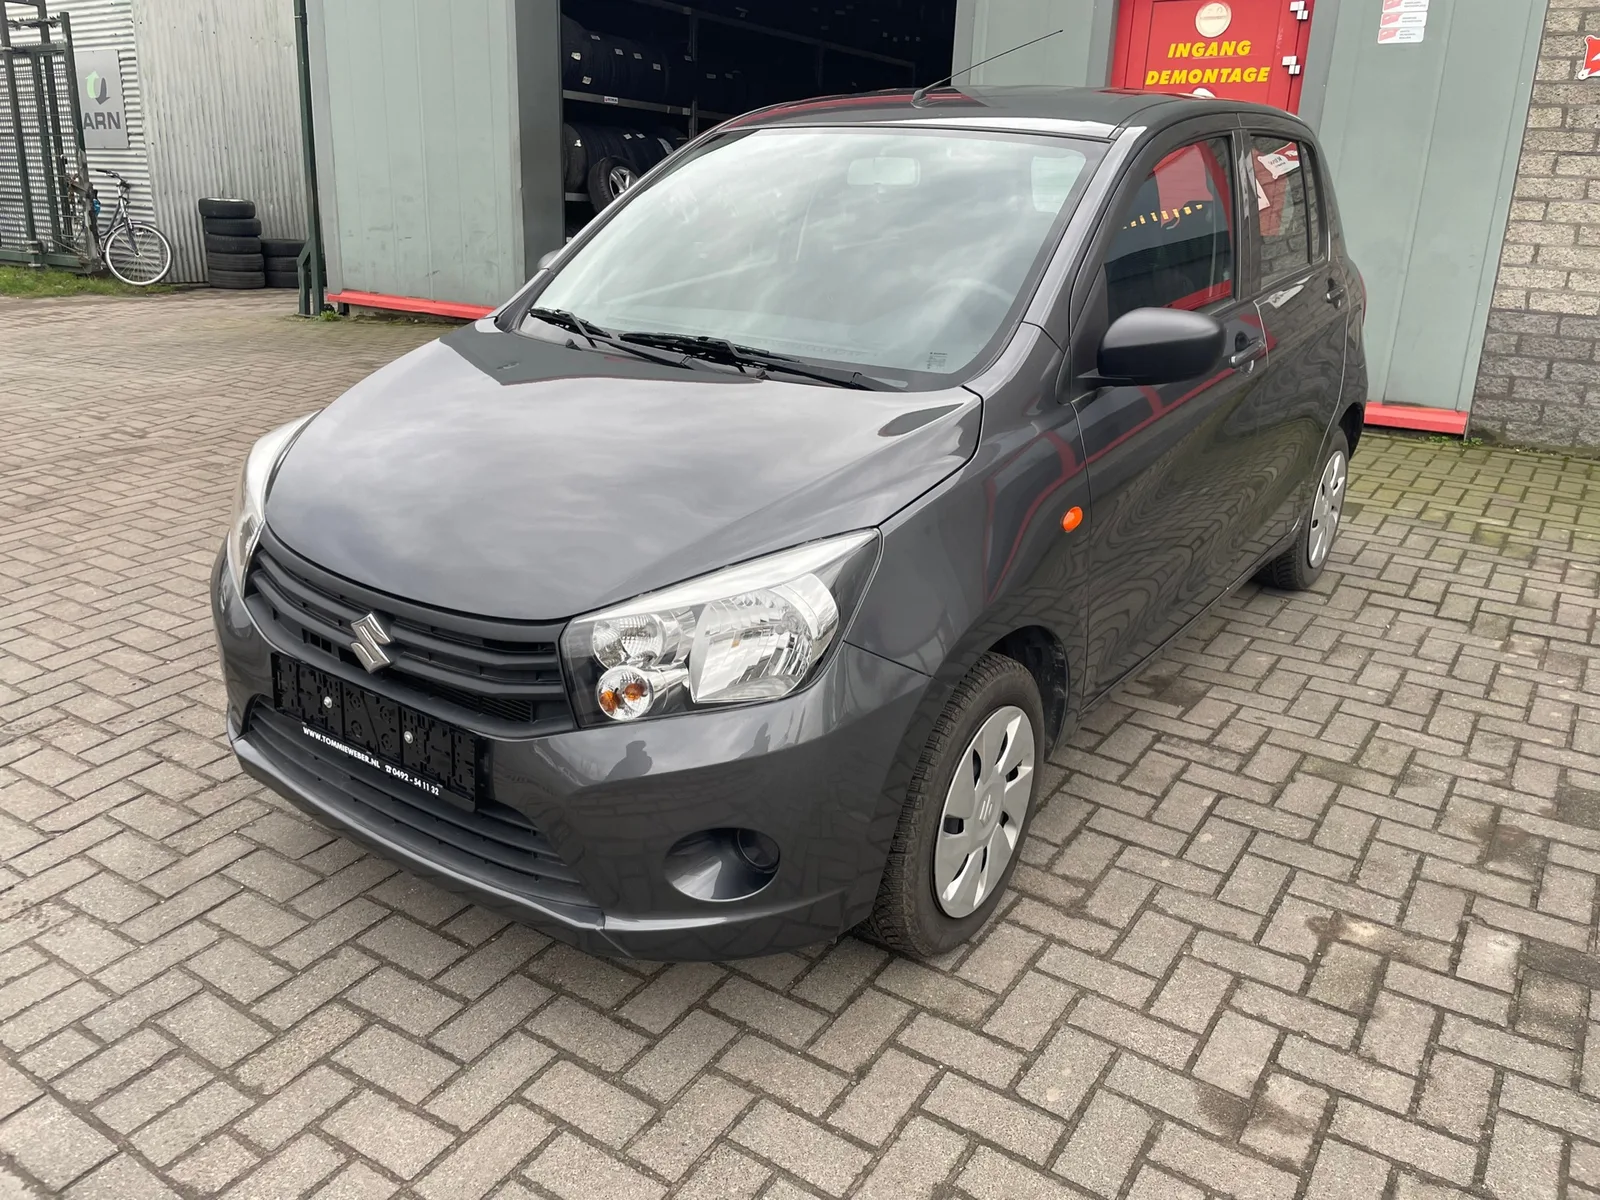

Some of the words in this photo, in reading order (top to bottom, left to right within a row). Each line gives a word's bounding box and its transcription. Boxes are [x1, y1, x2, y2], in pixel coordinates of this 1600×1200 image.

[1167, 40, 1251, 59] INGANG
[1145, 67, 1271, 85] DEMONTAGE
[83, 111, 121, 130] ARN
[302, 726, 380, 769] WWW.TOMMIEWEBER.NL
[392, 767, 409, 782] 0492
